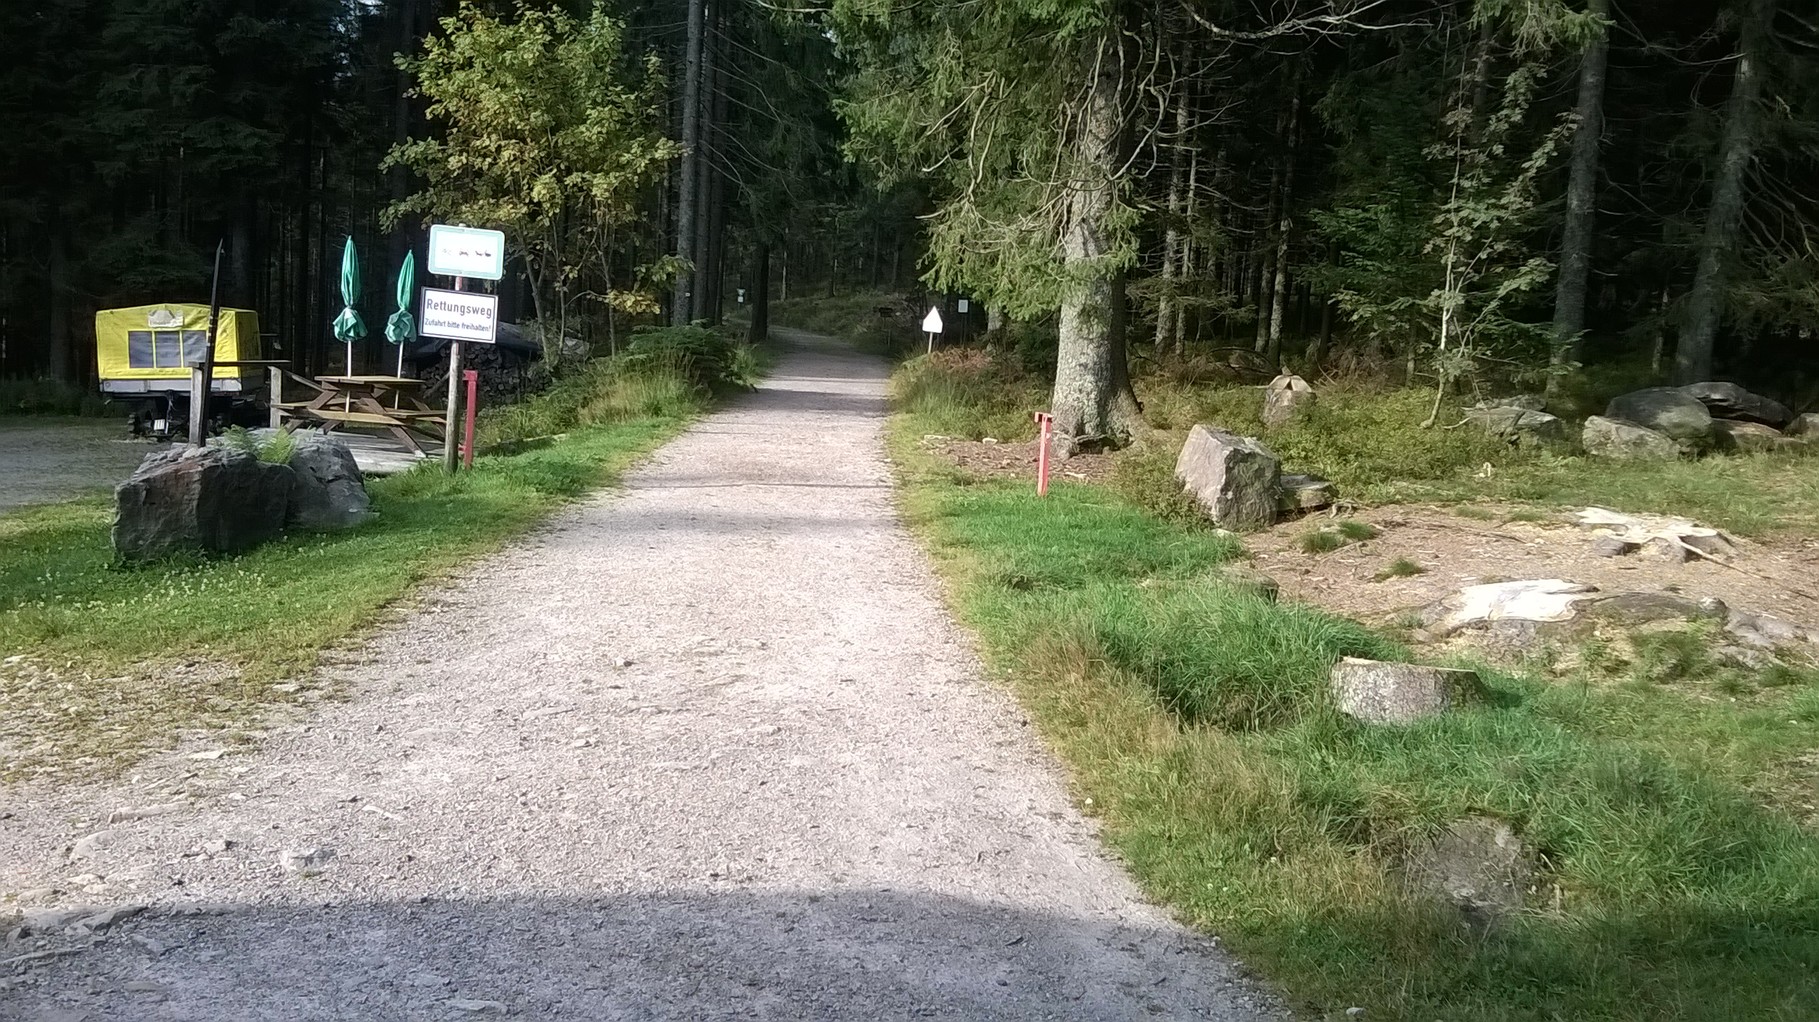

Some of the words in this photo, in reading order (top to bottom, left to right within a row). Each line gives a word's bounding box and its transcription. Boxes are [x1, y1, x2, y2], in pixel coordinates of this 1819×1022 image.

[426, 298, 492, 319] Rettungsweg
[425, 318, 446, 327] Zufahrt
[447, 320, 460, 329] bitte
[461, 322, 491, 332] freihalten!
